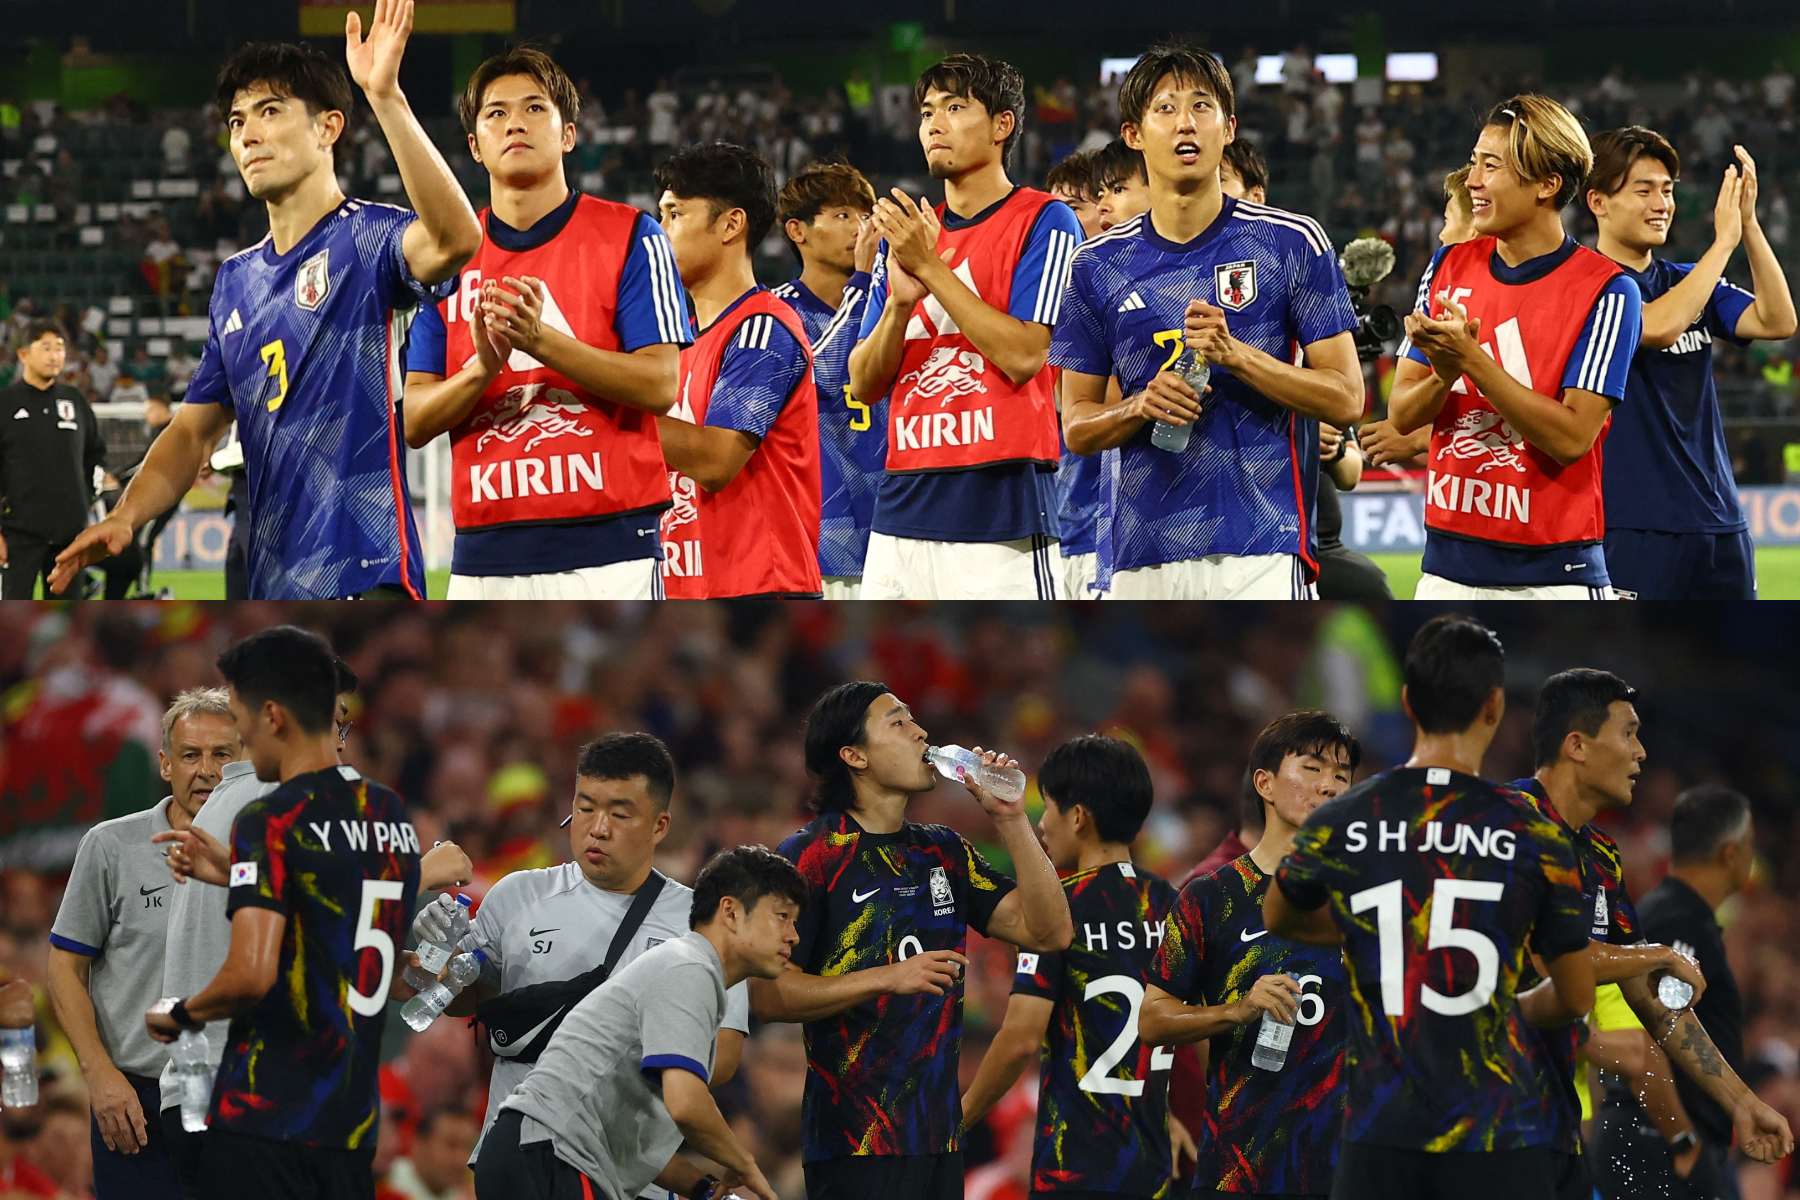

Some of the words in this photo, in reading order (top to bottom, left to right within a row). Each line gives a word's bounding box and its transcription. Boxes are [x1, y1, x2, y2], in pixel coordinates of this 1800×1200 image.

[1661, 326, 1712, 355] RIN
[261, 339, 289, 412] 3
[895, 406, 995, 451] KIRIN
[470, 452, 604, 503] KIRIN
[1427, 470, 1530, 523] KIRIN
[1353, 497, 1425, 545] FA
[1739, 491, 1800, 538] IO
[310, 821, 331, 851] Y
[340, 820, 368, 851] W
[373, 821, 421, 853] PAR
[1345, 821, 1368, 853] S
[1378, 820, 1408, 852] H
[1417, 821, 1517, 860] JUNG
[933, 906, 956, 917] KOREA
[347, 879, 404, 1017] 5
[532, 940, 553, 954] SJ
[1083, 922, 1108, 951] H
[1116, 921, 1136, 950] S
[1143, 920, 1166, 949] H
[1350, 879, 1505, 1017] 15
[1296, 974, 1325, 1026] 6
